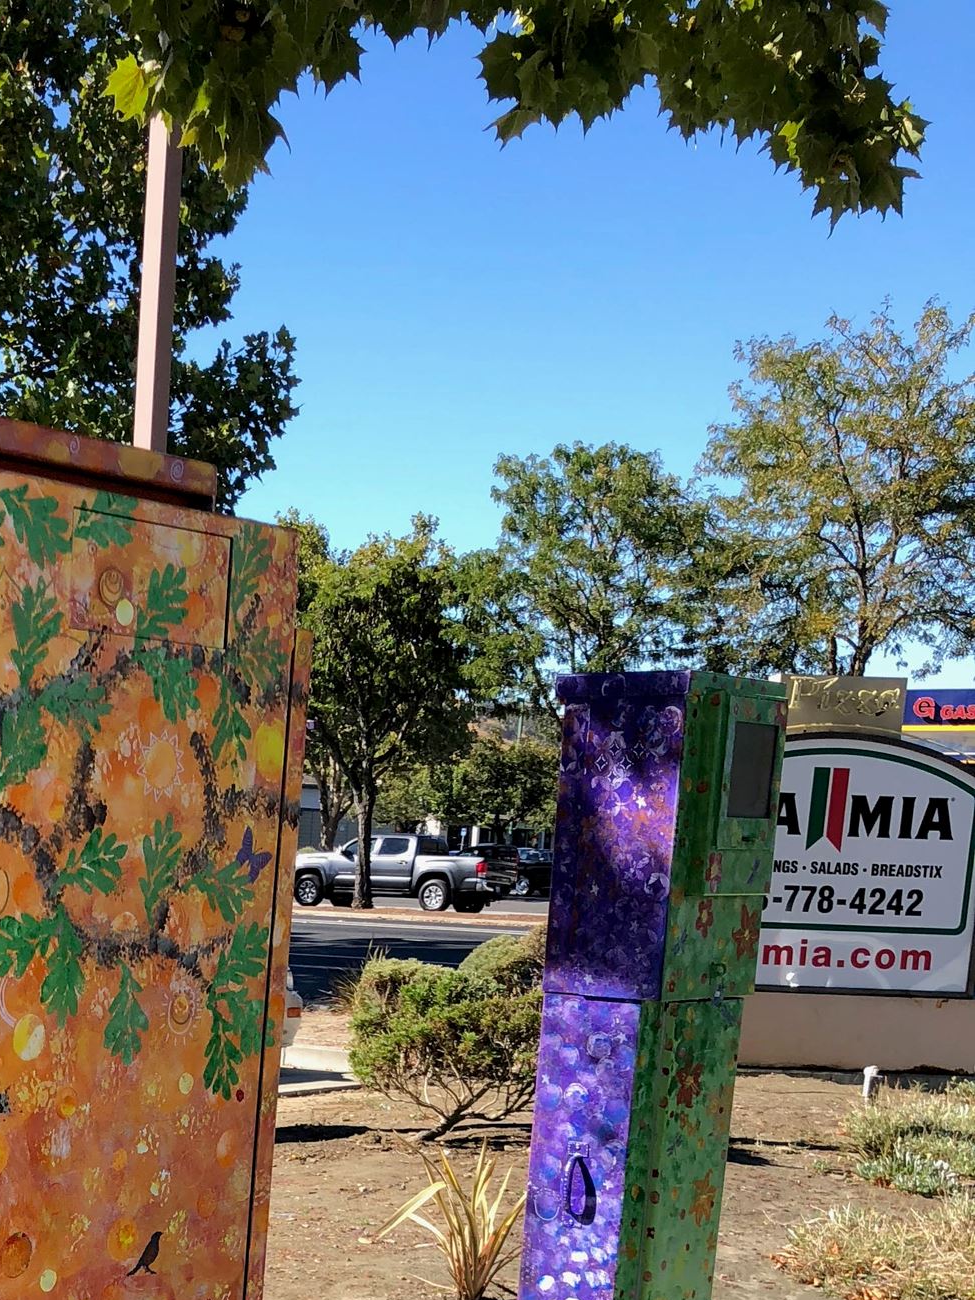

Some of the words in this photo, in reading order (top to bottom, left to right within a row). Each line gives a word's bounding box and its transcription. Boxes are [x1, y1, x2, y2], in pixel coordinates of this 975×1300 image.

[788, 676, 901, 716] Pizza
[847, 794, 953, 840] MIA
[810, 861, 859, 876] SALADS
[870, 863, 943, 878] BREADSTIX
[761, 939, 932, 971] mia.com
